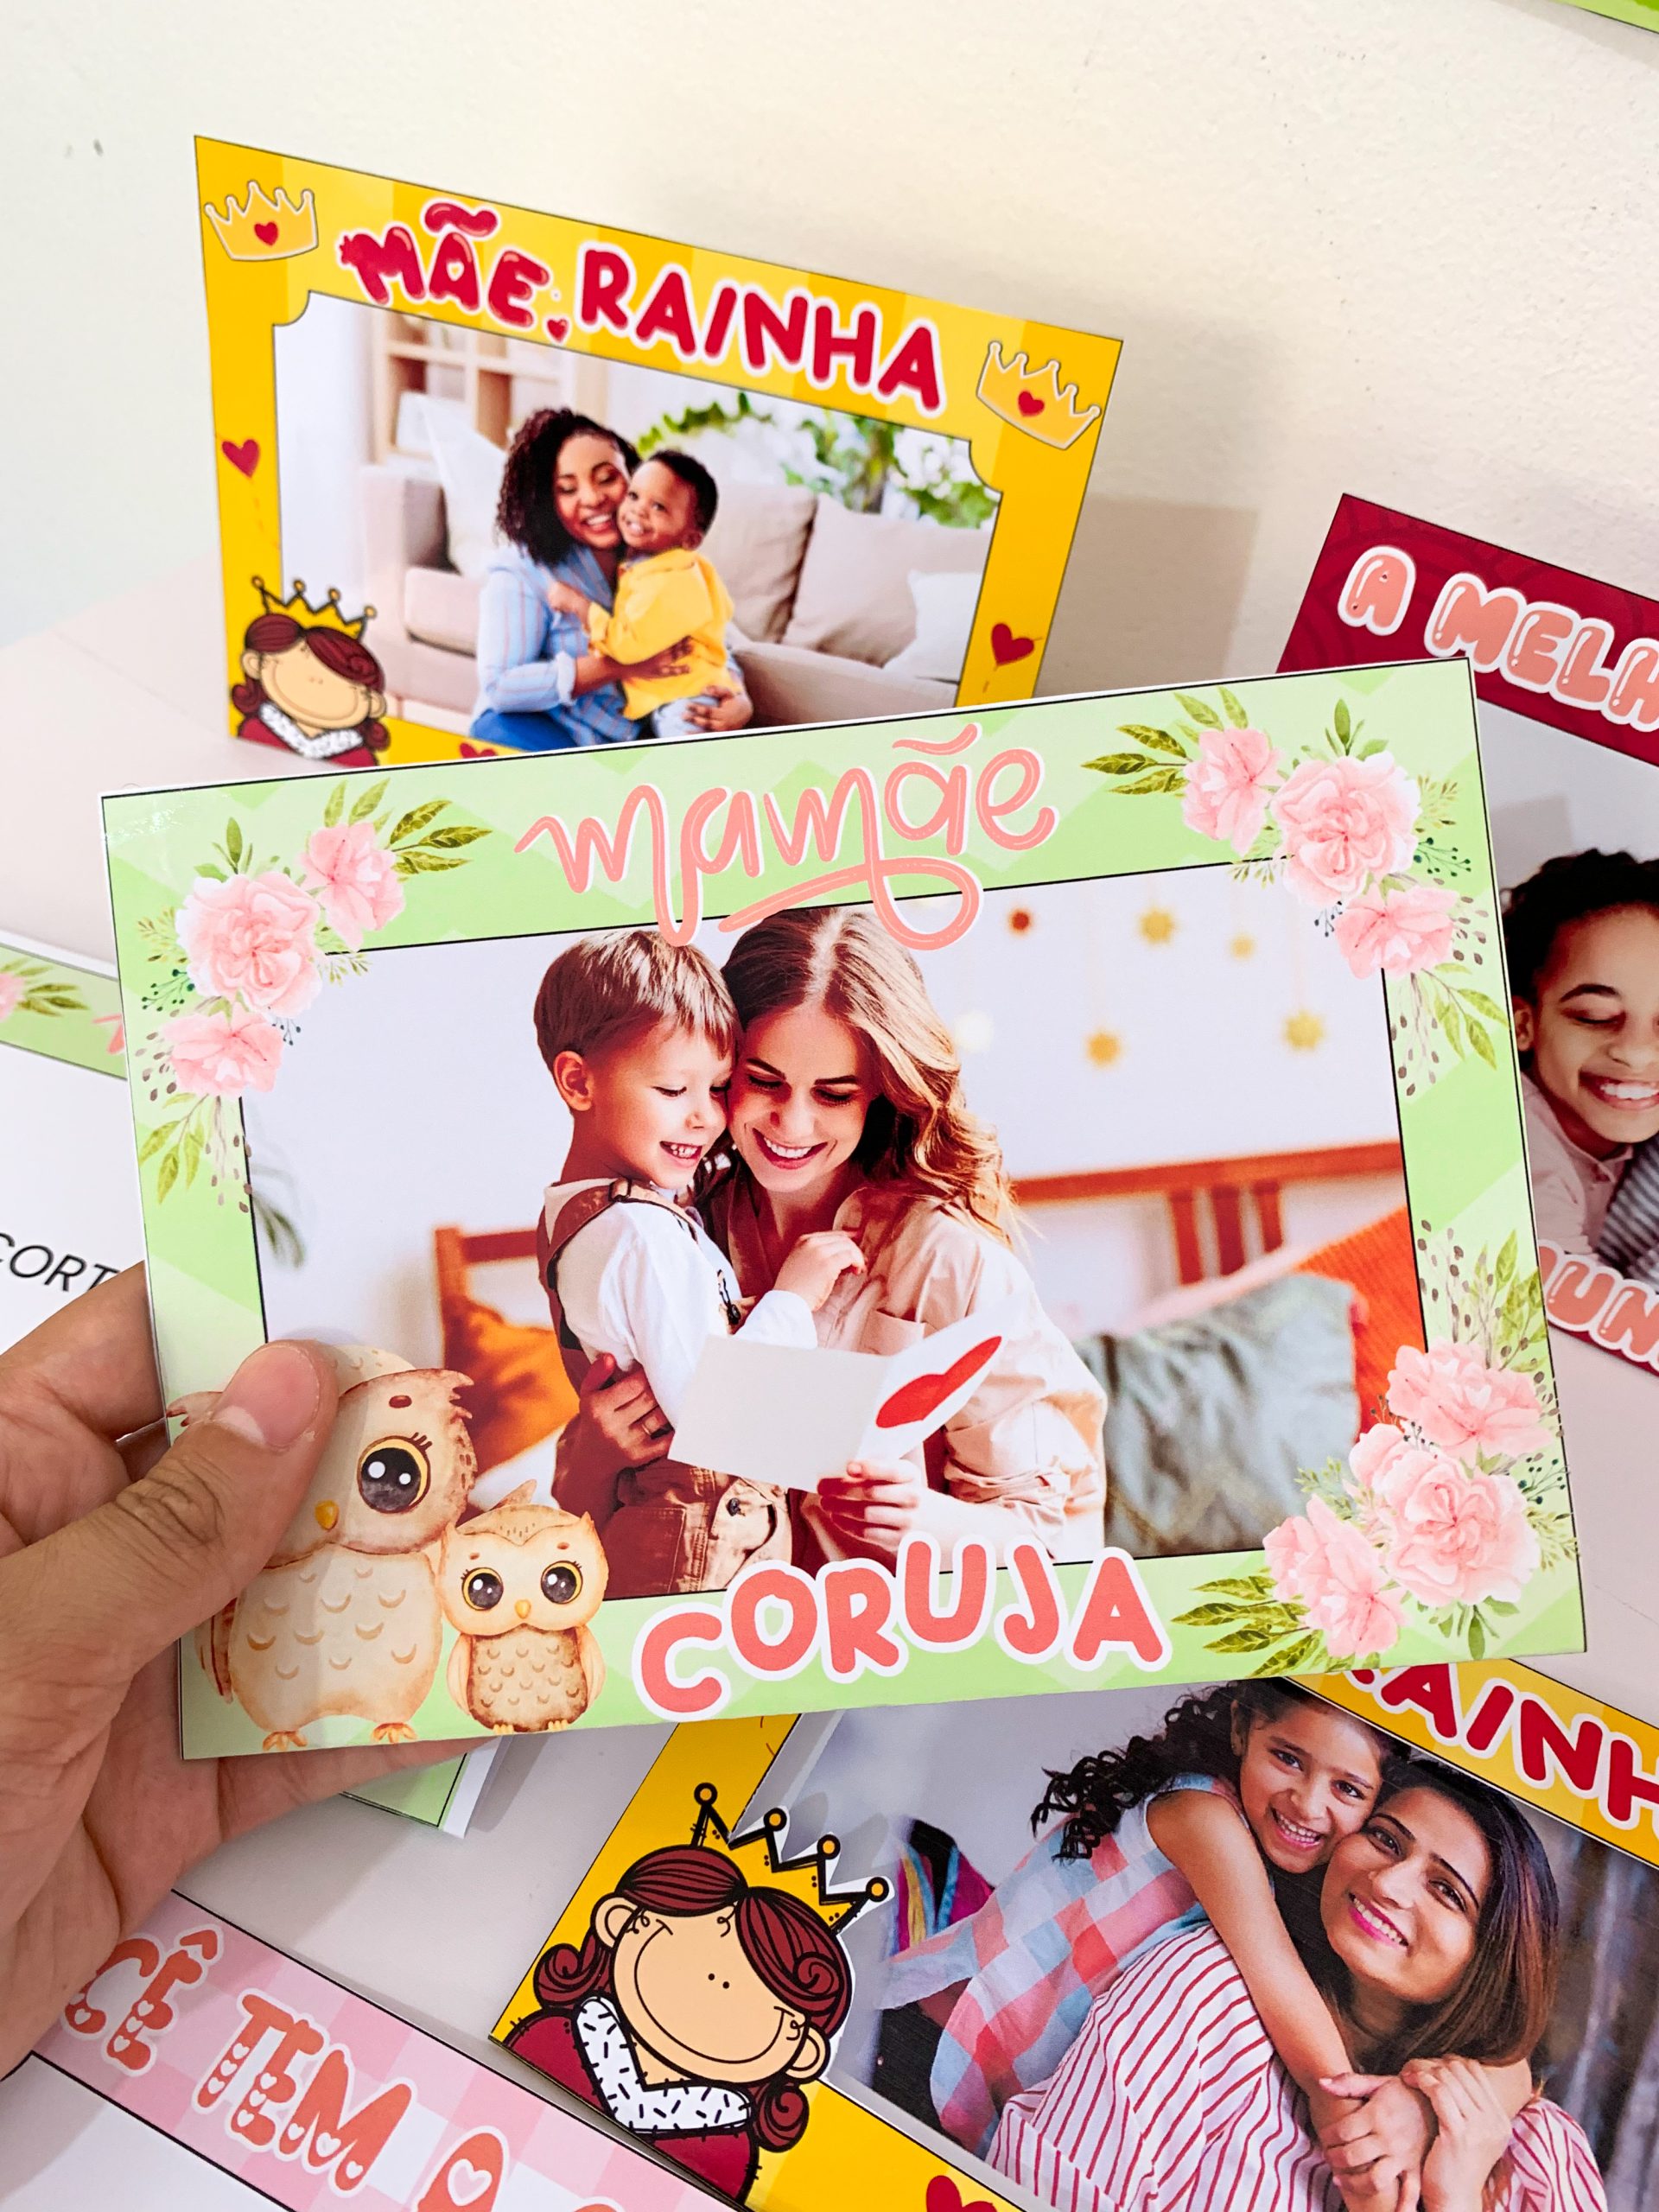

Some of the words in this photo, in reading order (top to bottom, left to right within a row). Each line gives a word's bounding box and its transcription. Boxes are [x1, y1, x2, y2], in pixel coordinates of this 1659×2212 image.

[339, 201, 552, 329] MÃE
[580, 247, 943, 412] RAINHA
[1342, 549, 1412, 632] A
[638, 1538, 1166, 1715] CORUJA
[1350, 1662, 1659, 1824] AINH
[193, 1992, 414, 2193] TEM
